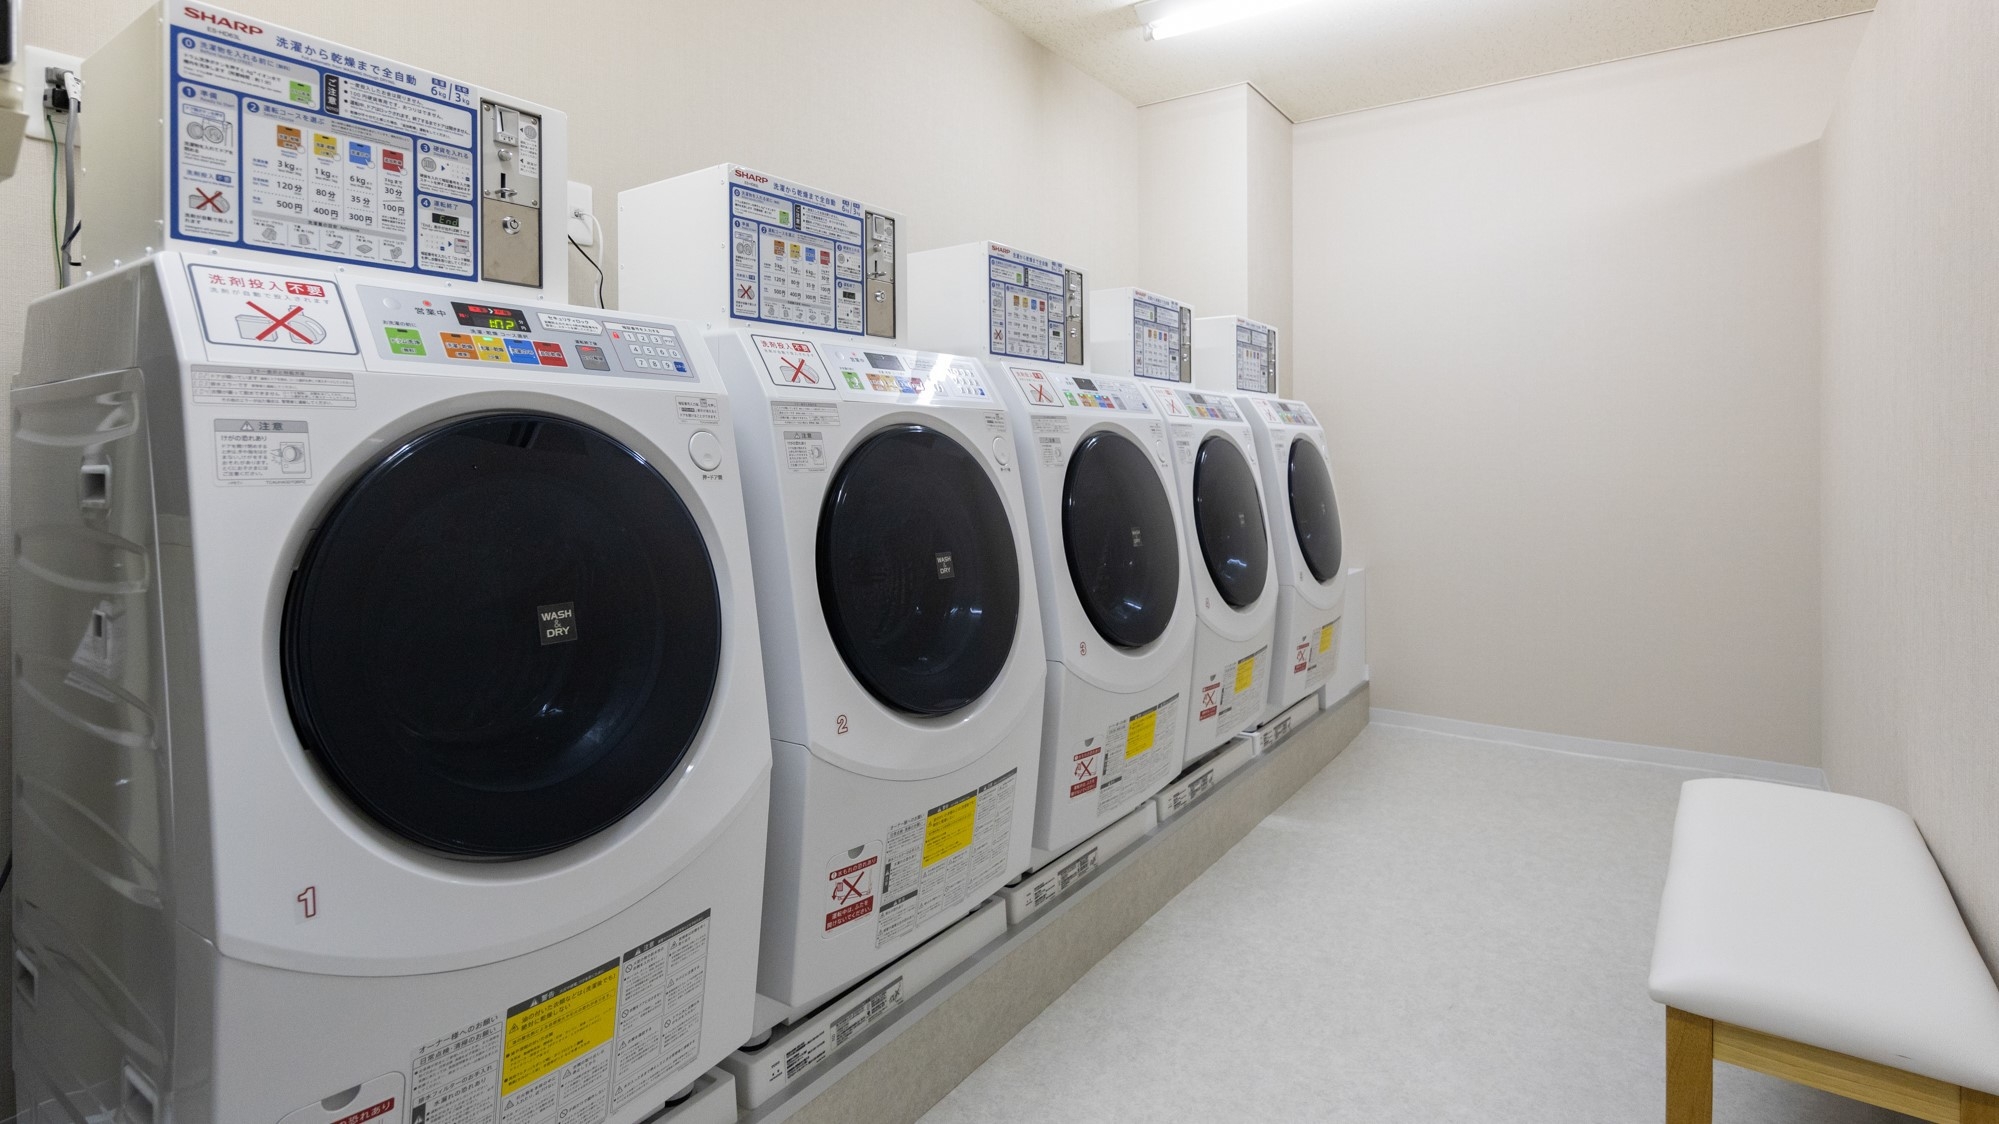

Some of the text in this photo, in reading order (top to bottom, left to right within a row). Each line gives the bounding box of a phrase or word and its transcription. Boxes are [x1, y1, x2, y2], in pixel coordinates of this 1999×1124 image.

[184, 7, 263, 34] SHARP
[277, 36, 416, 86] 洗濯から乾燥まで全自動
[328, 77, 336, 106] ご注意
[249, 102, 256, 112] 2
[263, 104, 324, 126] 運転コースを選ぶ
[735, 169, 768, 184] SHARP
[773, 183, 836, 206] 洗濯から乾燥まで全自動
[276, 199, 302, 211] 500円
[433, 200, 458, 210] 運転終了
[313, 206, 338, 218] 400円
[348, 212, 372, 223] 300円
[439, 215, 458, 226] End
[992, 245, 1010, 254] SHARP
[208, 273, 323, 297] 洗剤投入 不要
[414, 307, 446, 317] 営業中
[760, 340, 791, 350] 洗剤投入
[259, 422, 283, 430] 注意
[541, 610, 572, 621] WASH
[546, 626, 570, 637] DRY
[1080, 642, 1086, 656] 3
[837, 715, 848, 734] 2
[298, 886, 317, 918] 1
[420, 1016, 498, 1053] オーナー様へのお願い
[420, 1027, 496, 1064] 日常点検・清掃のお願い
